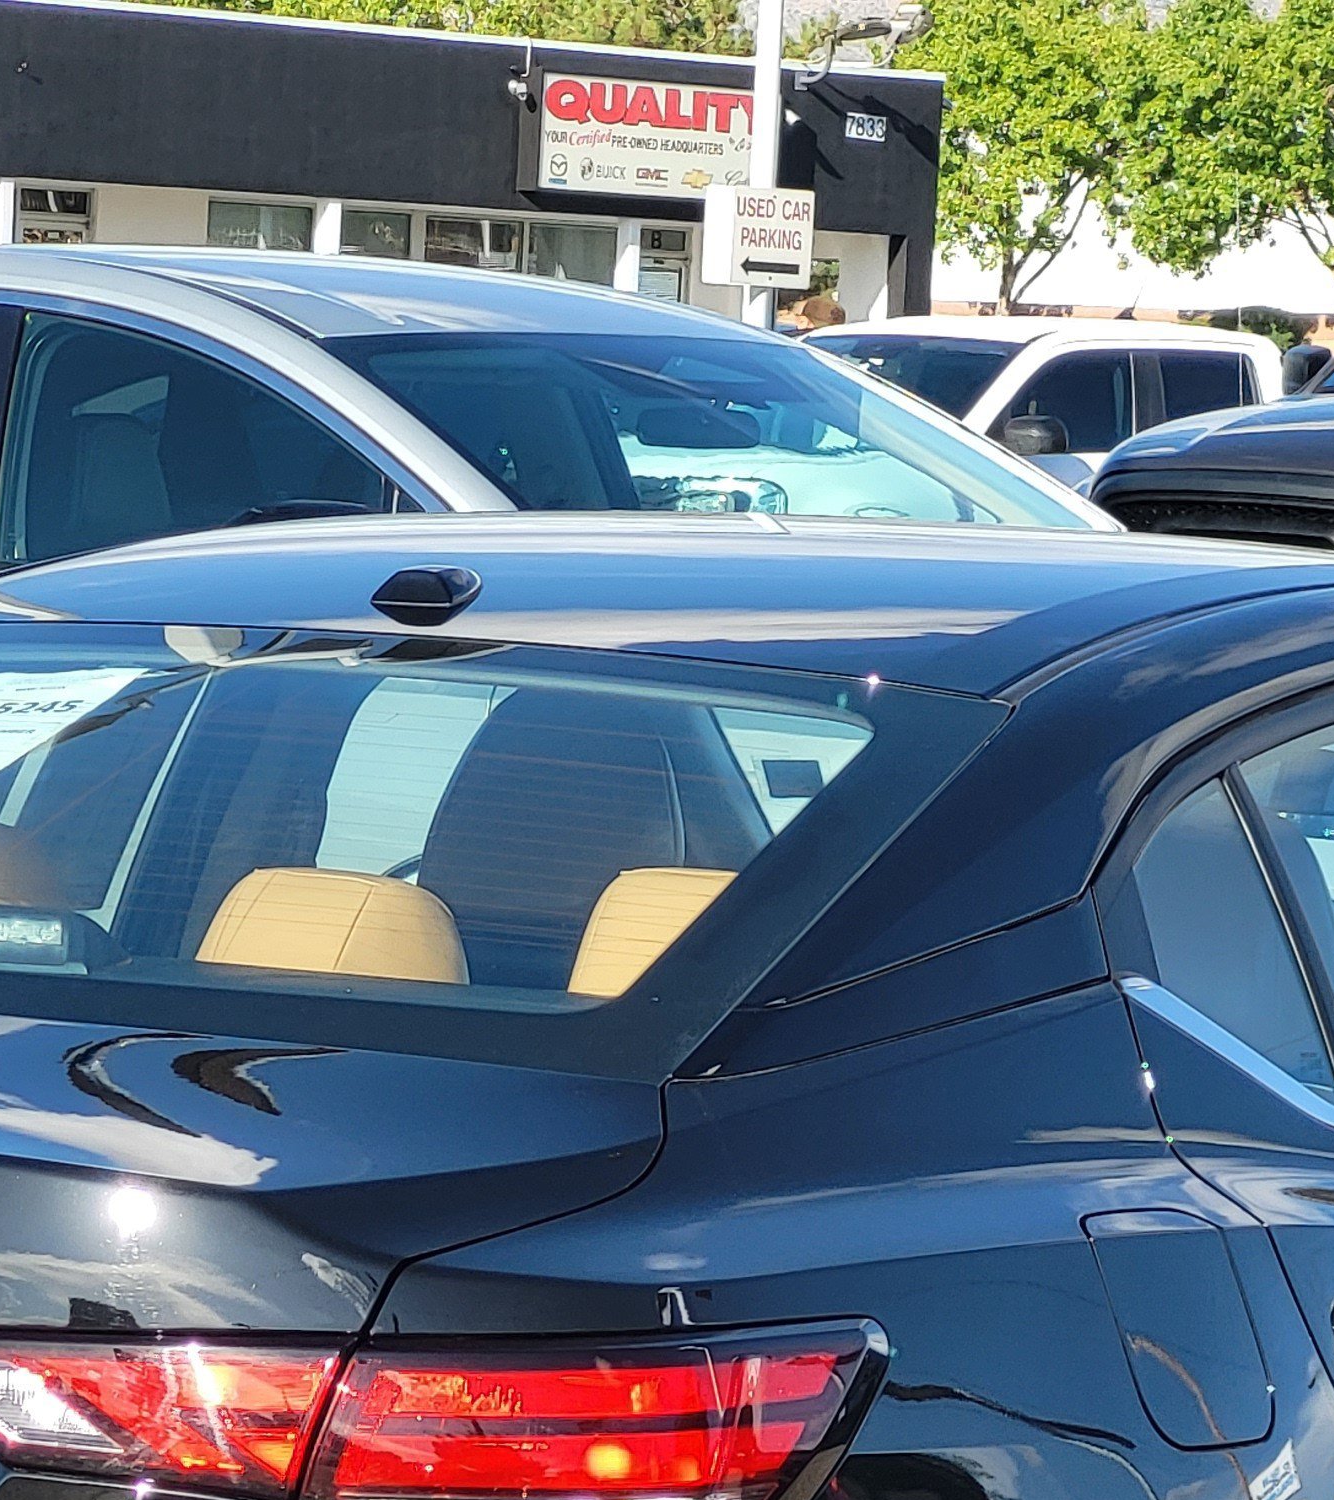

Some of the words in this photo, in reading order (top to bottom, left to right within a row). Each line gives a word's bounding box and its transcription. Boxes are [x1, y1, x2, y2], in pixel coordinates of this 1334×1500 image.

[846, 115, 885, 139] 7833
[545, 130, 568, 143] YOUR
[569, 129, 611, 148] Certified
[611, 135, 659, 151] PRE-OWNED
[660, 137, 724, 156] HEADQUARTERS
[596, 164, 627, 180] BUICK
[636, 167, 669, 181] GMC
[736, 195, 777, 218] USED
[782, 200, 811, 222] CAR
[740, 227, 802, 251] PARKING
